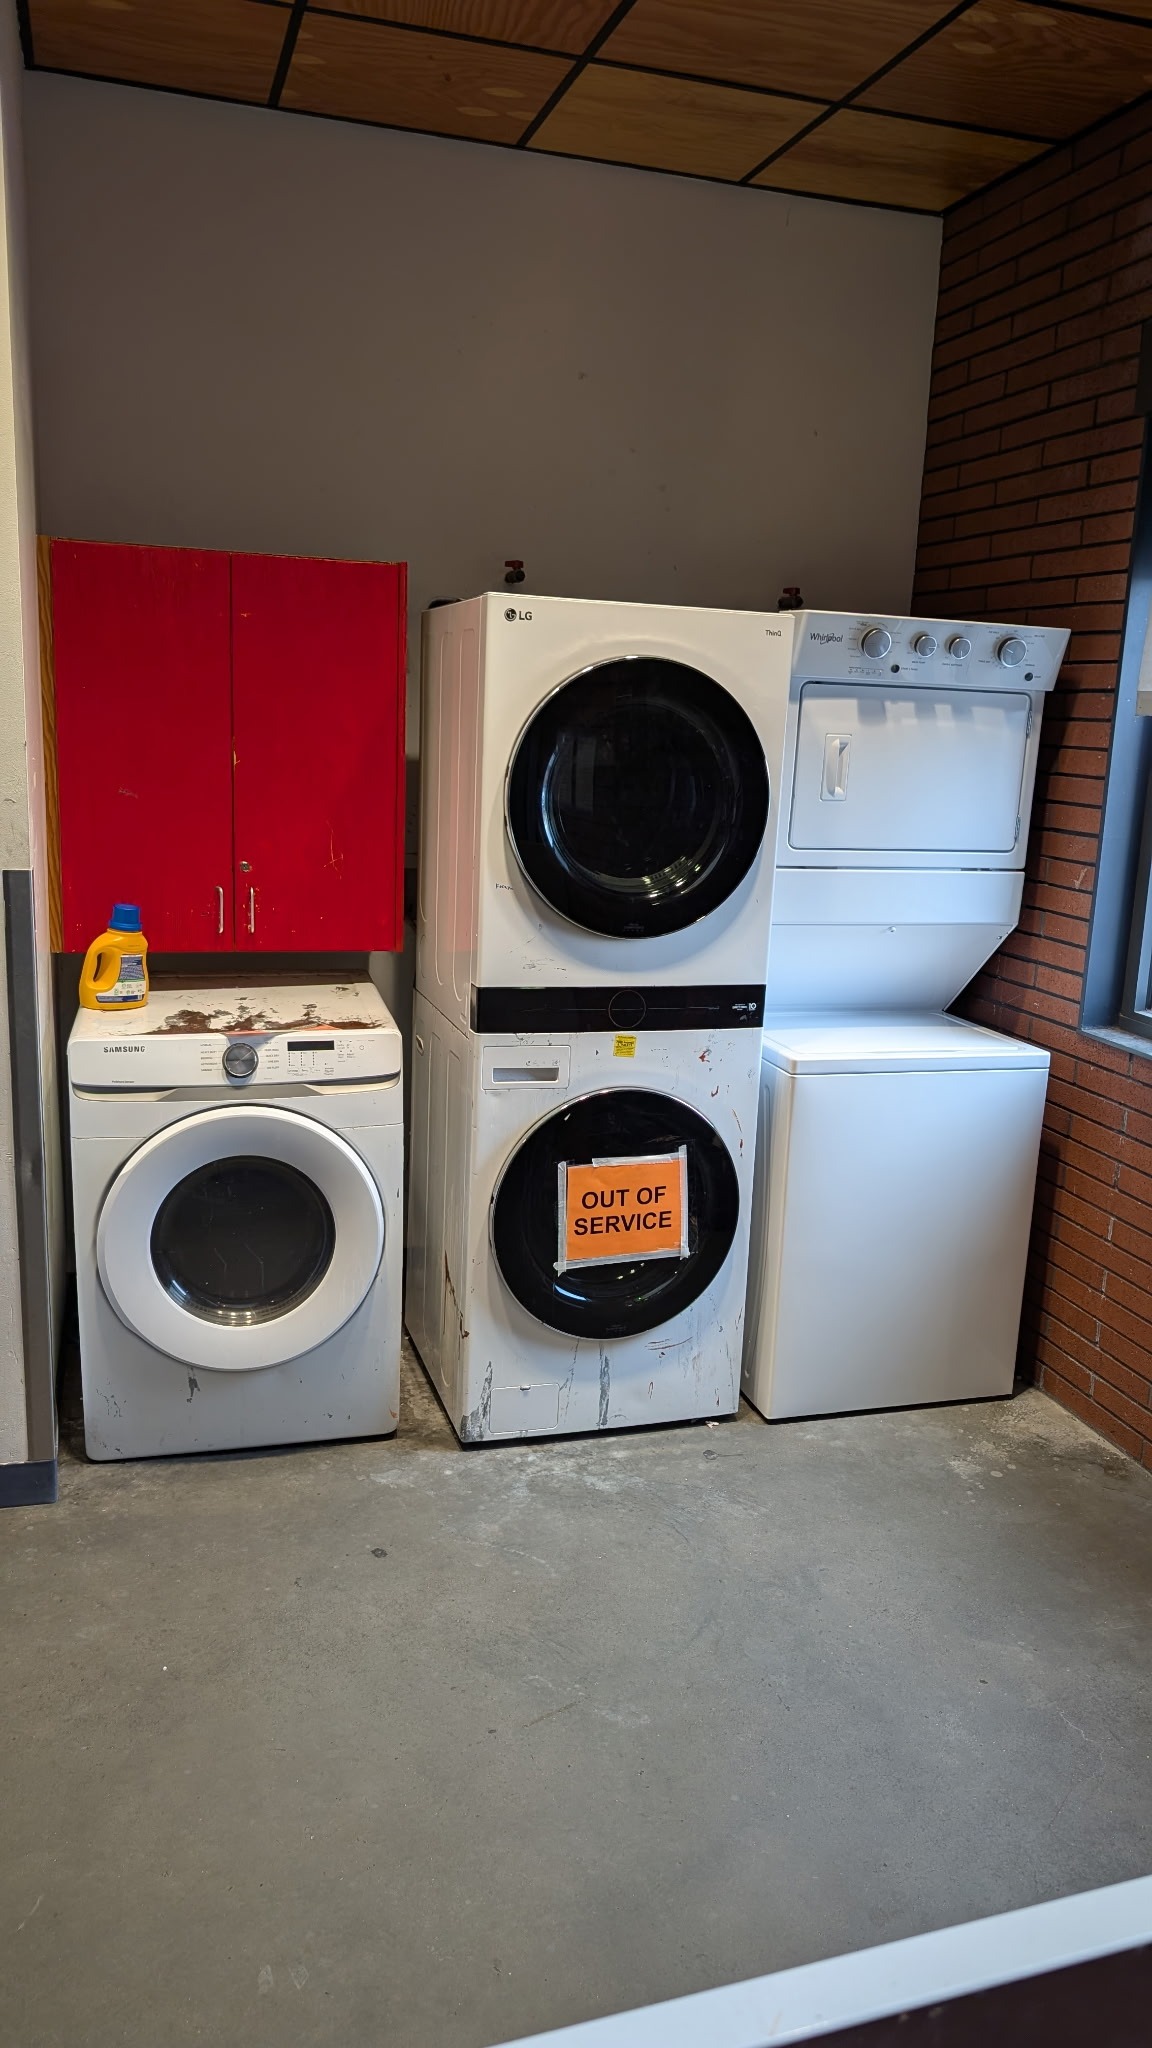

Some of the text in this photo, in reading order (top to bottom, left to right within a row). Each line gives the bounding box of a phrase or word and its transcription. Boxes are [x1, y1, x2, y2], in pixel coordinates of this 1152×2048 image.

[765, 629, 782, 637] ThinQ
[810, 632, 843, 645] Whirlpool
[103, 1045, 146, 1053] SAMSUNG
[581, 1185, 667, 1209] OUT OF
[573, 1210, 672, 1236] SERVICE
